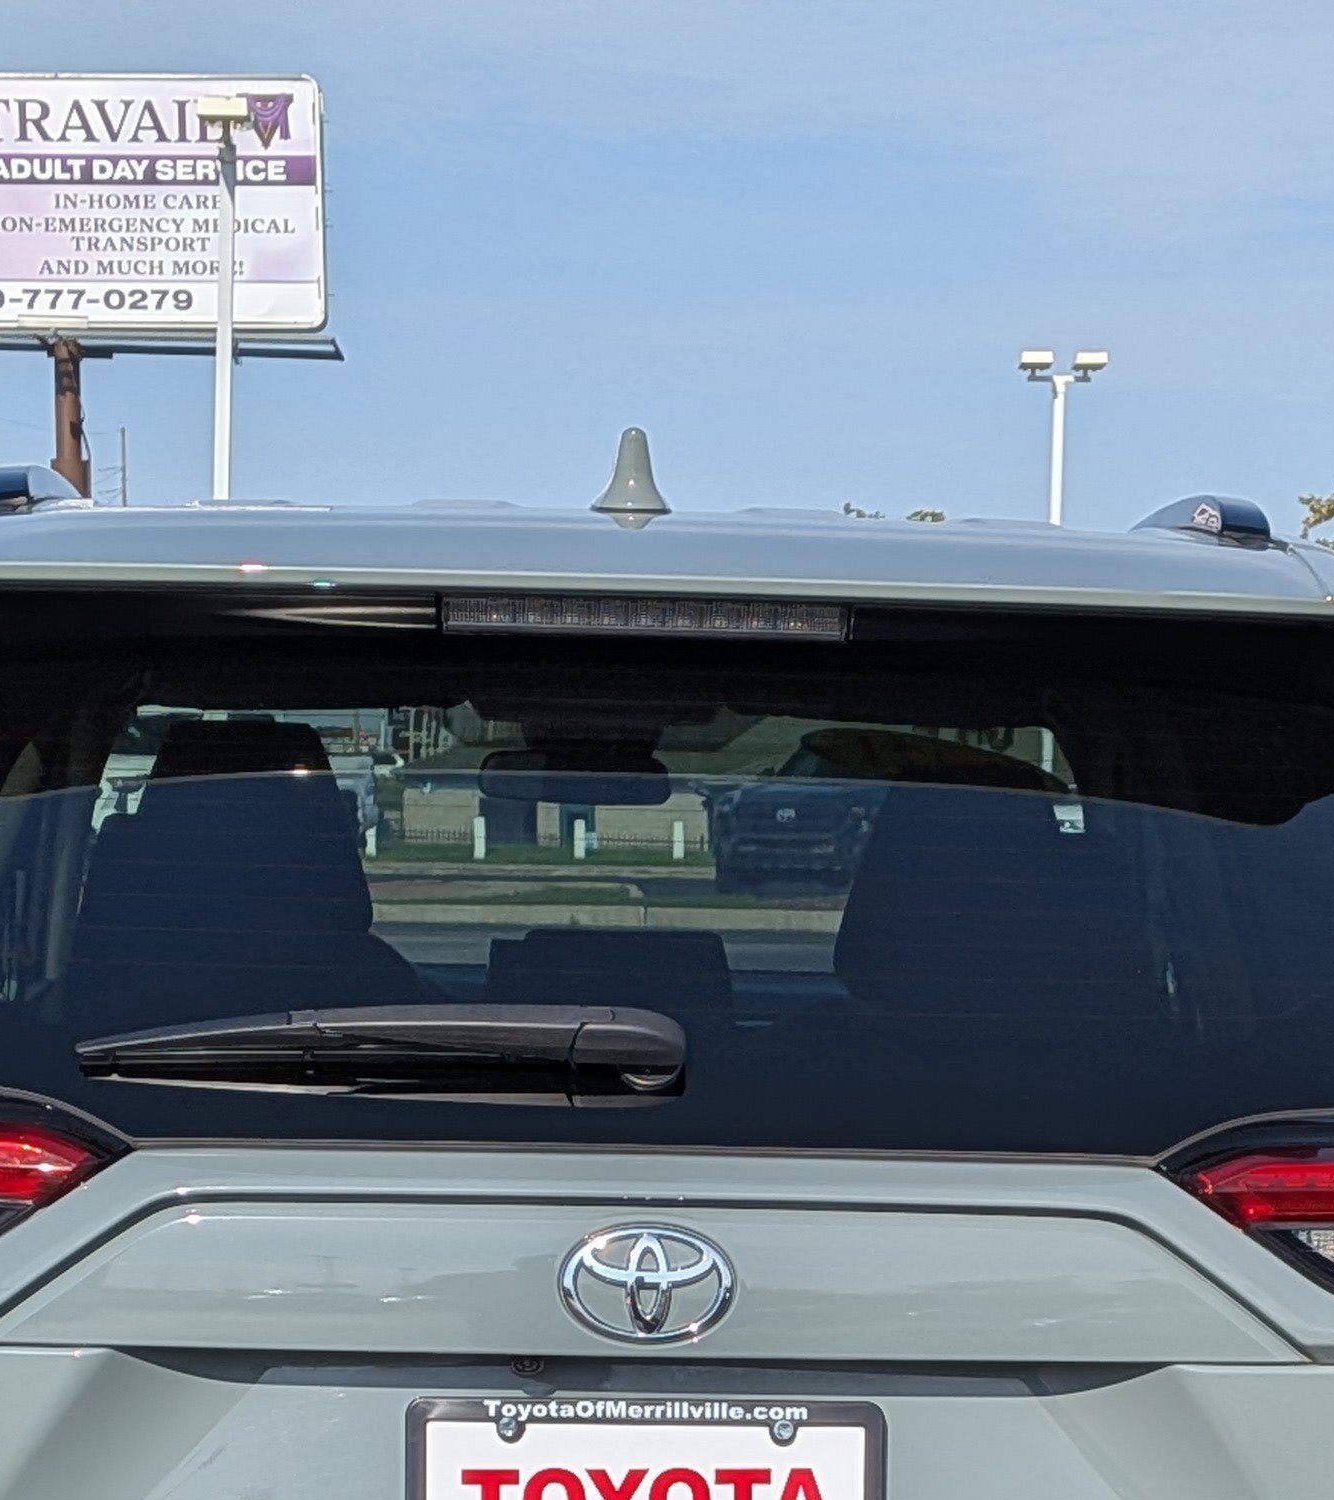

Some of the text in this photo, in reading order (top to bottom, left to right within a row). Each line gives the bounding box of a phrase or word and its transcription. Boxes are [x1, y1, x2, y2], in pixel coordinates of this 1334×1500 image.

[92, 159, 151, 181] DAY
[54, 193, 156, 210] IN-HOME
[70, 235, 210, 252] TRANSPORT
[38, 259, 89, 275] AND
[96, 259, 164, 275] MUCH
[483, 1399, 809, 1422] ToyotaOfMerrillville.com
